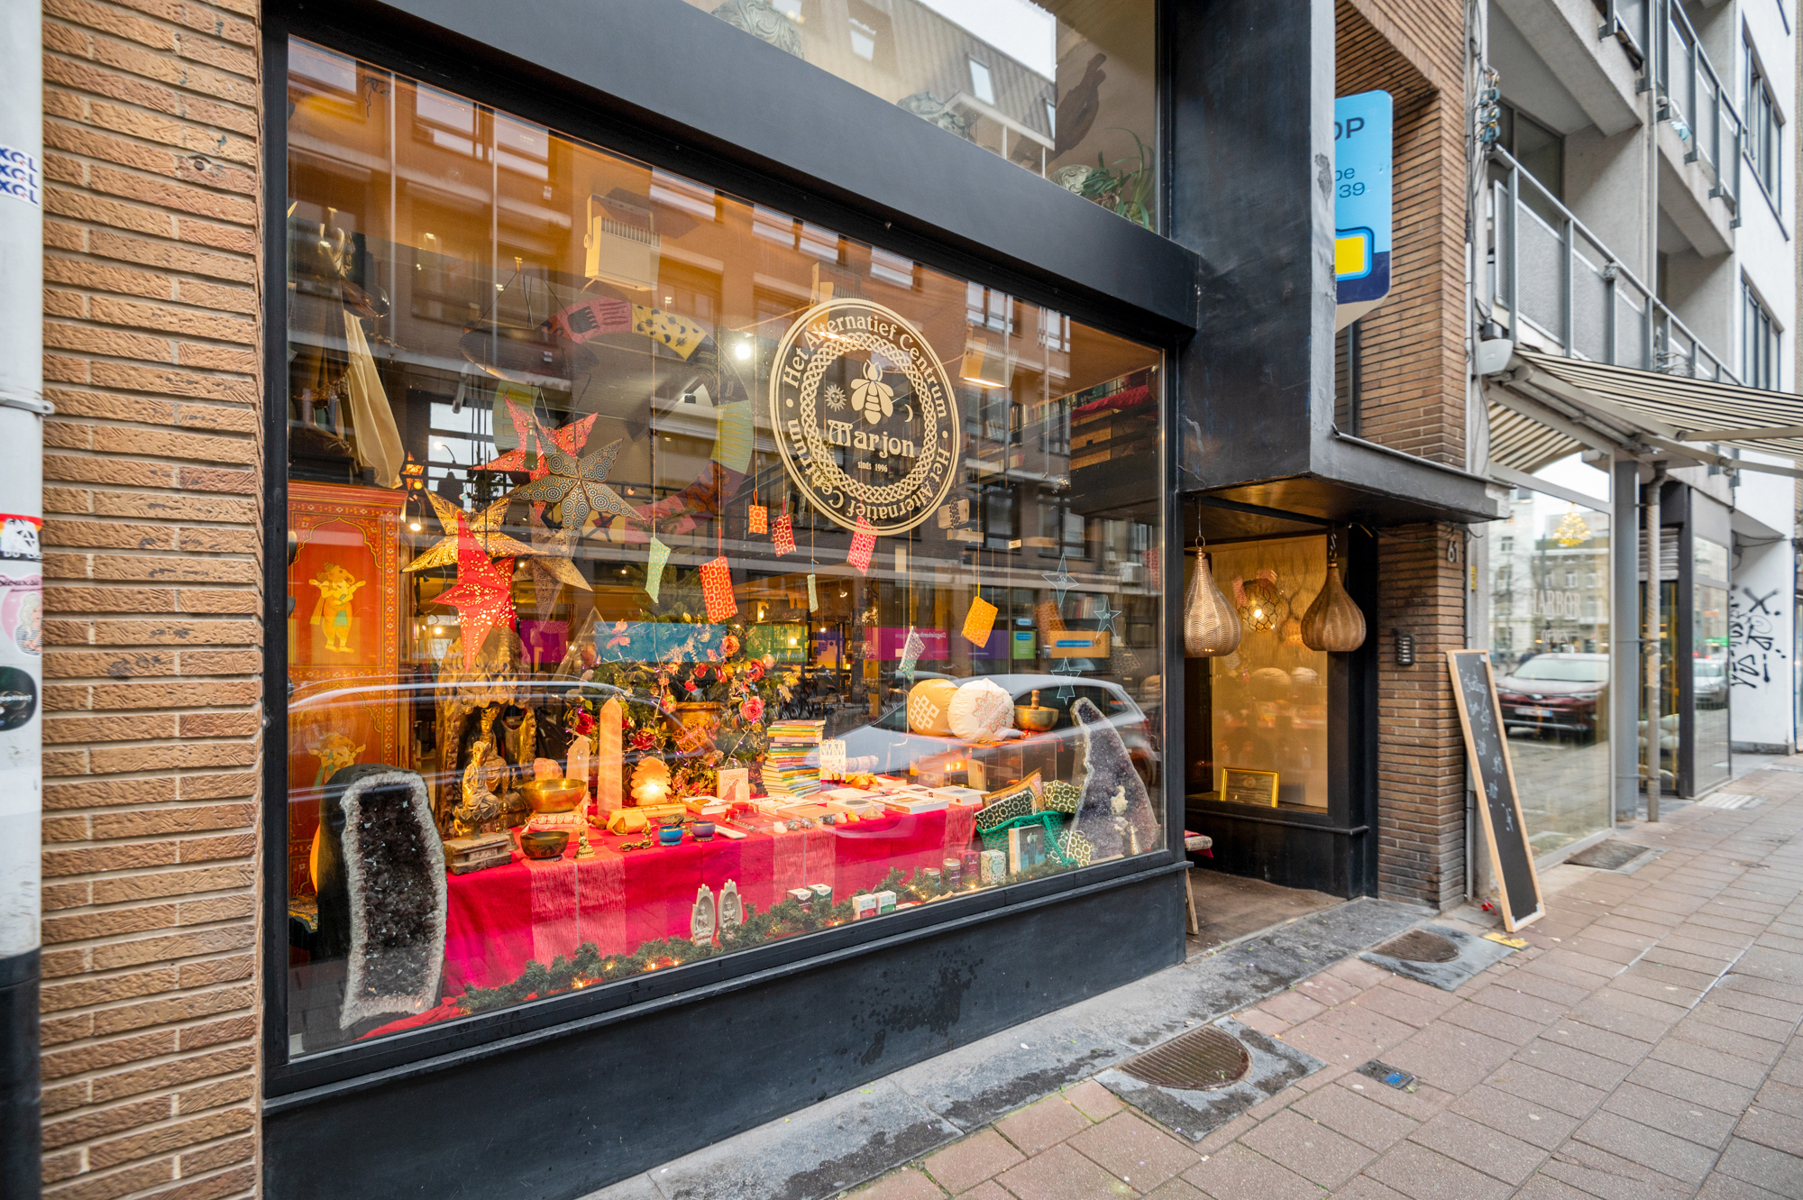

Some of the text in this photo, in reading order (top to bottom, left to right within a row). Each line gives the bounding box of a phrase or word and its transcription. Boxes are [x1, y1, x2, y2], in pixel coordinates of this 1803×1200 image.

[1339, 181, 1366, 199] 39
[782, 315, 948, 419] Het Alternatief Centrum
[827, 419, 915, 459] Marjon
[787, 418, 951, 524] Het Alternatief Centrum
[857, 461, 872, 471] sinds
[1447, 541, 1460, 563] 61
